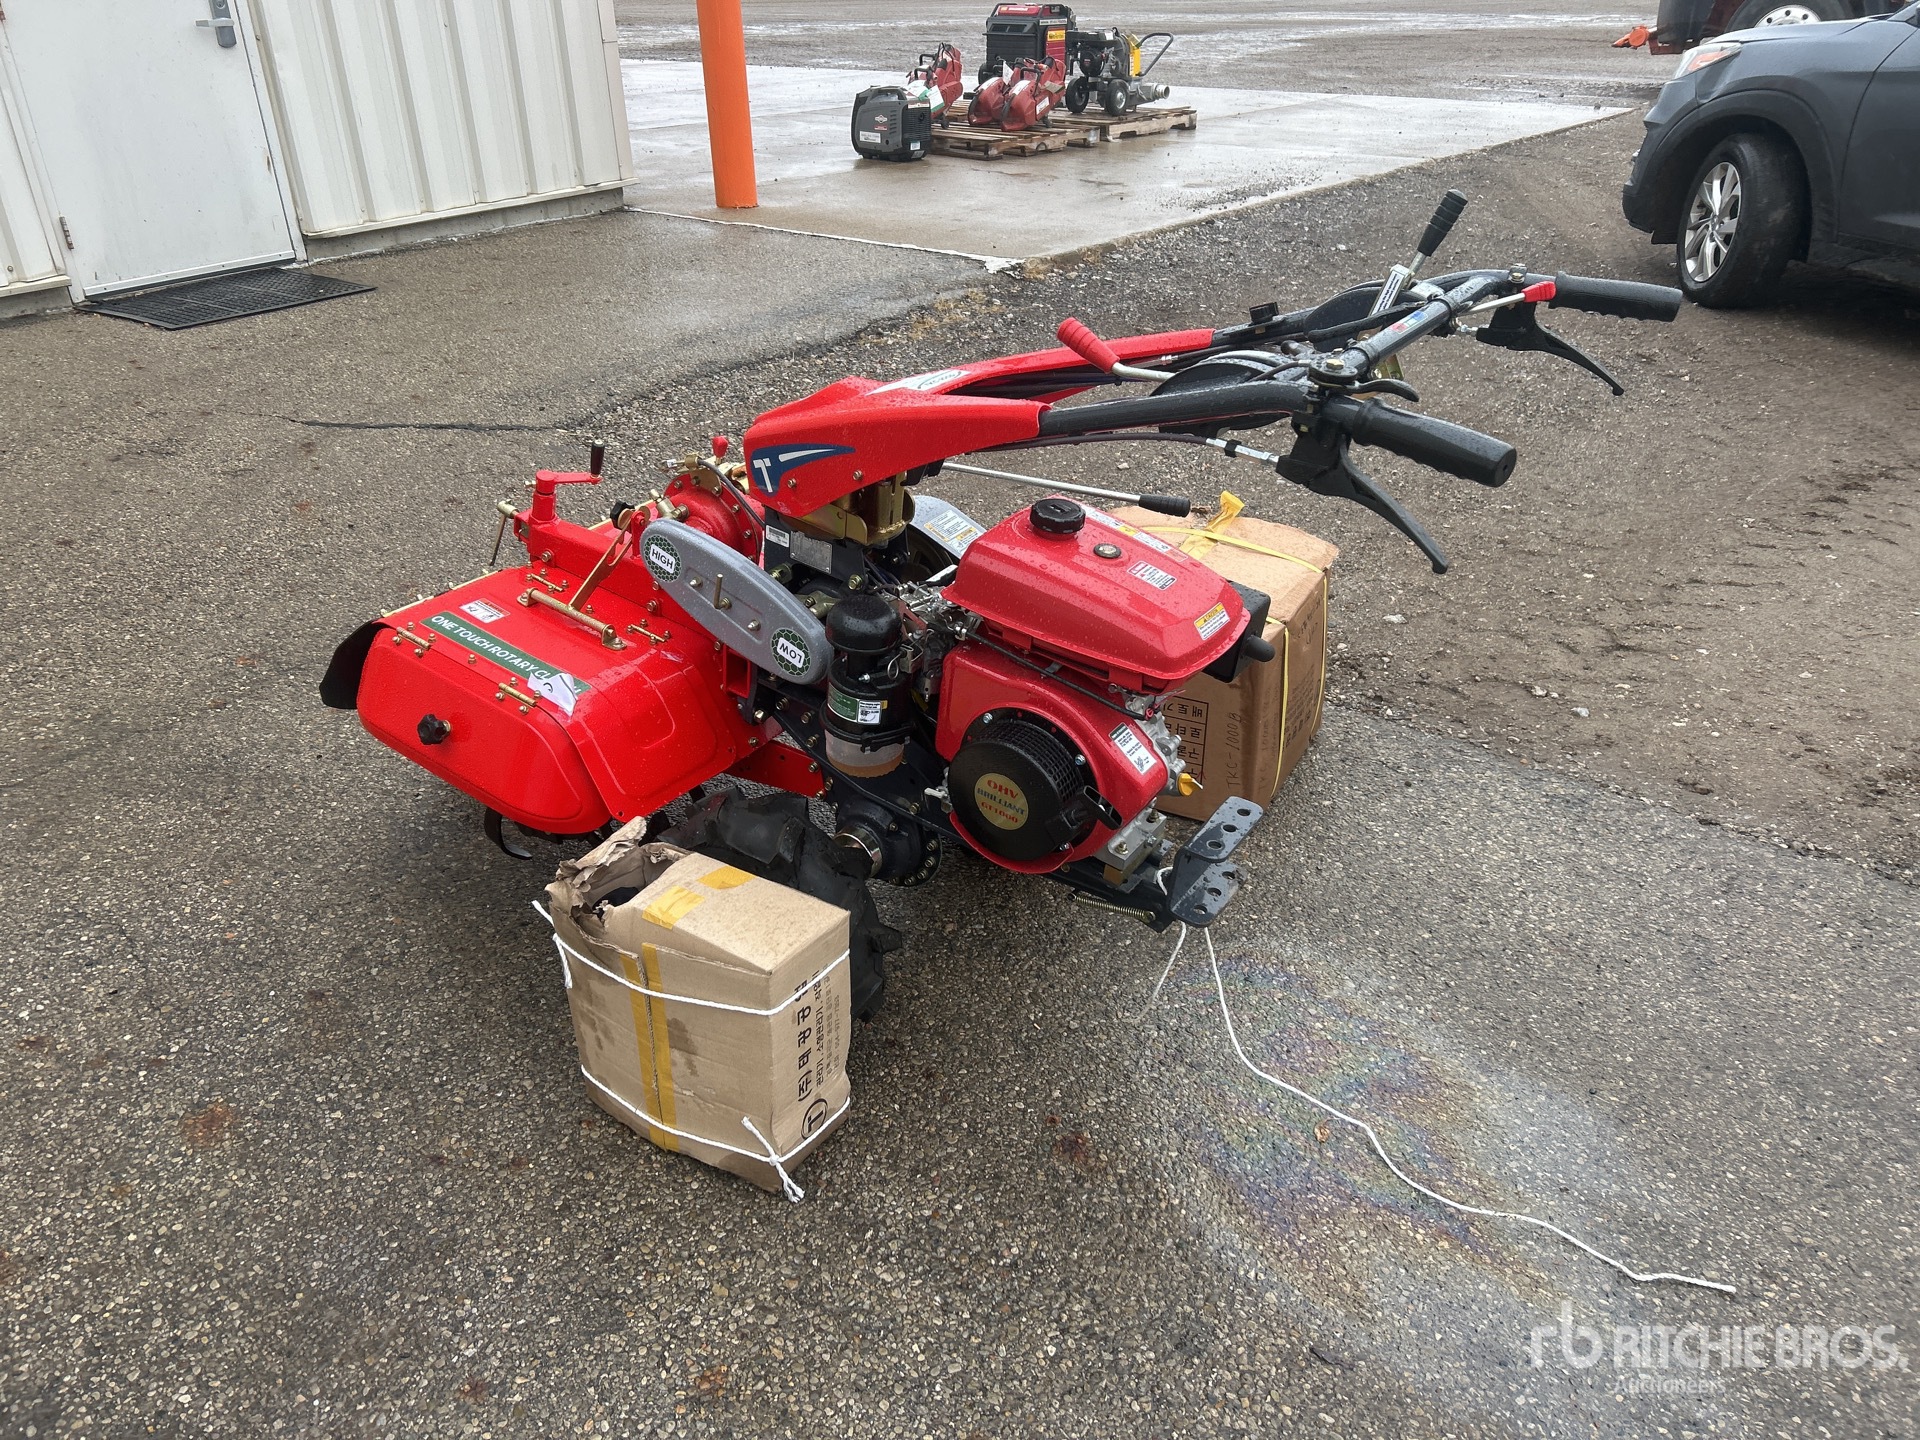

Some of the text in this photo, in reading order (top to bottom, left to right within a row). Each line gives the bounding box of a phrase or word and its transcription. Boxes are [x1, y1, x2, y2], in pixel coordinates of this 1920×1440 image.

[753, 458, 772, 492] T
[652, 548, 674, 569] HIGH
[431, 615, 536, 672] ONE TOUCH ROTARY
[779, 643, 803, 664] LOW
[987, 780, 1018, 799] OHV
[977, 787, 1025, 815] BRILLIANT
[981, 801, 1018, 823] GT1000
